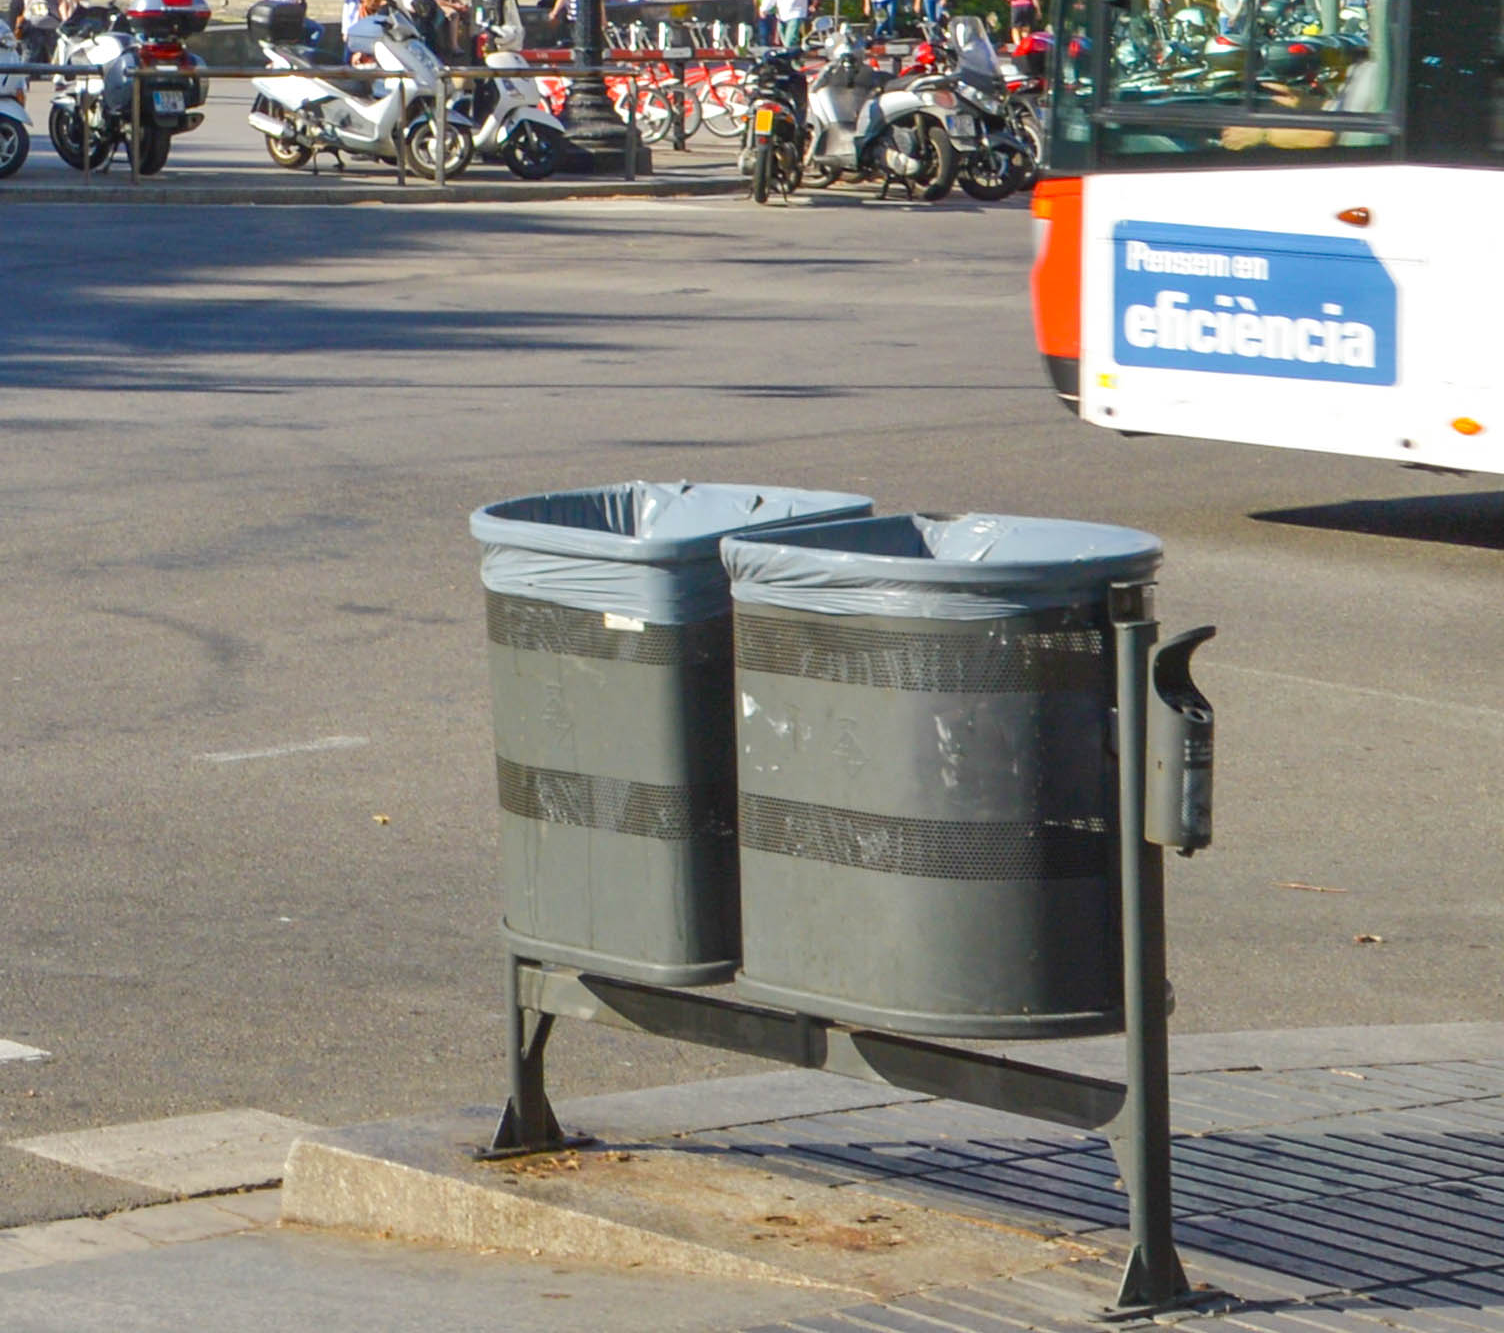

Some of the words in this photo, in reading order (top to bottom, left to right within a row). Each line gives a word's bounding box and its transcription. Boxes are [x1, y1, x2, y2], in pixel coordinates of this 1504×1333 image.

[1125, 239, 1232, 278] Pensem
[1231, 254, 1270, 281] en
[1123, 289, 1377, 368] eficiència
